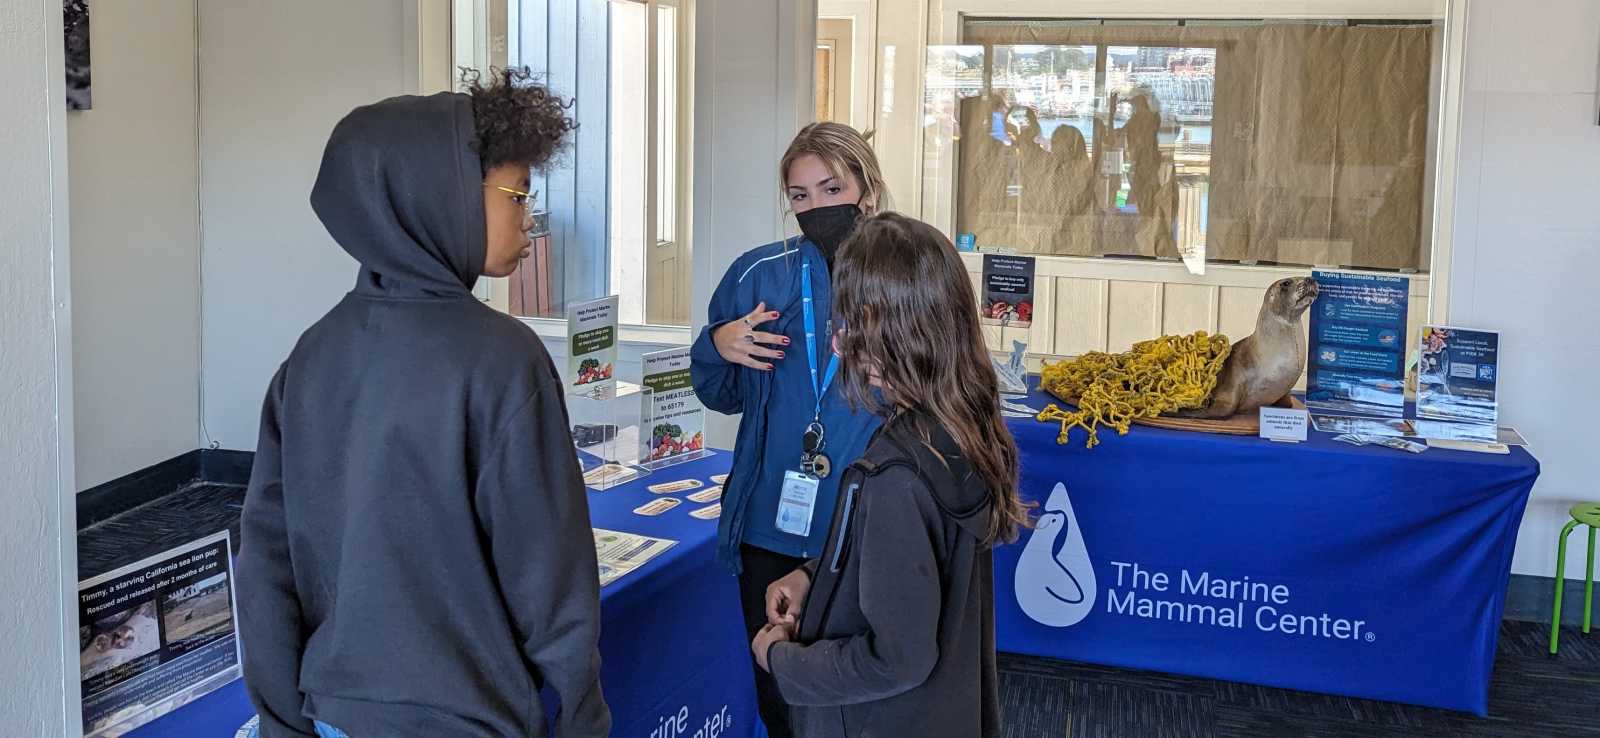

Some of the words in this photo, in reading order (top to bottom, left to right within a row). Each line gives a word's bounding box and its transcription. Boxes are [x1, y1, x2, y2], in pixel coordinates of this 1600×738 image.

[1320, 271, 1339, 279] Buying
[1341, 272, 1375, 280] Sustainable
[654, 395, 664, 403] Text
[666, 391, 695, 401] MEATLESS
[81, 589, 108, 602] Timmy,
[115, 575, 145, 591] starving
[145, 563, 178, 579] California
[179, 558, 190, 567] sea
[192, 553, 204, 561] lion
[86, 599, 115, 615] Rescued
[116, 594, 129, 604] and
[130, 583, 156, 599] released
[156, 580, 170, 589] after
[176, 570, 198, 581] months
[205, 561, 218, 570] care
[1110, 561, 1169, 592] The
[1180, 569, 1289, 604] Marine
[1107, 588, 1244, 628] Mammal
